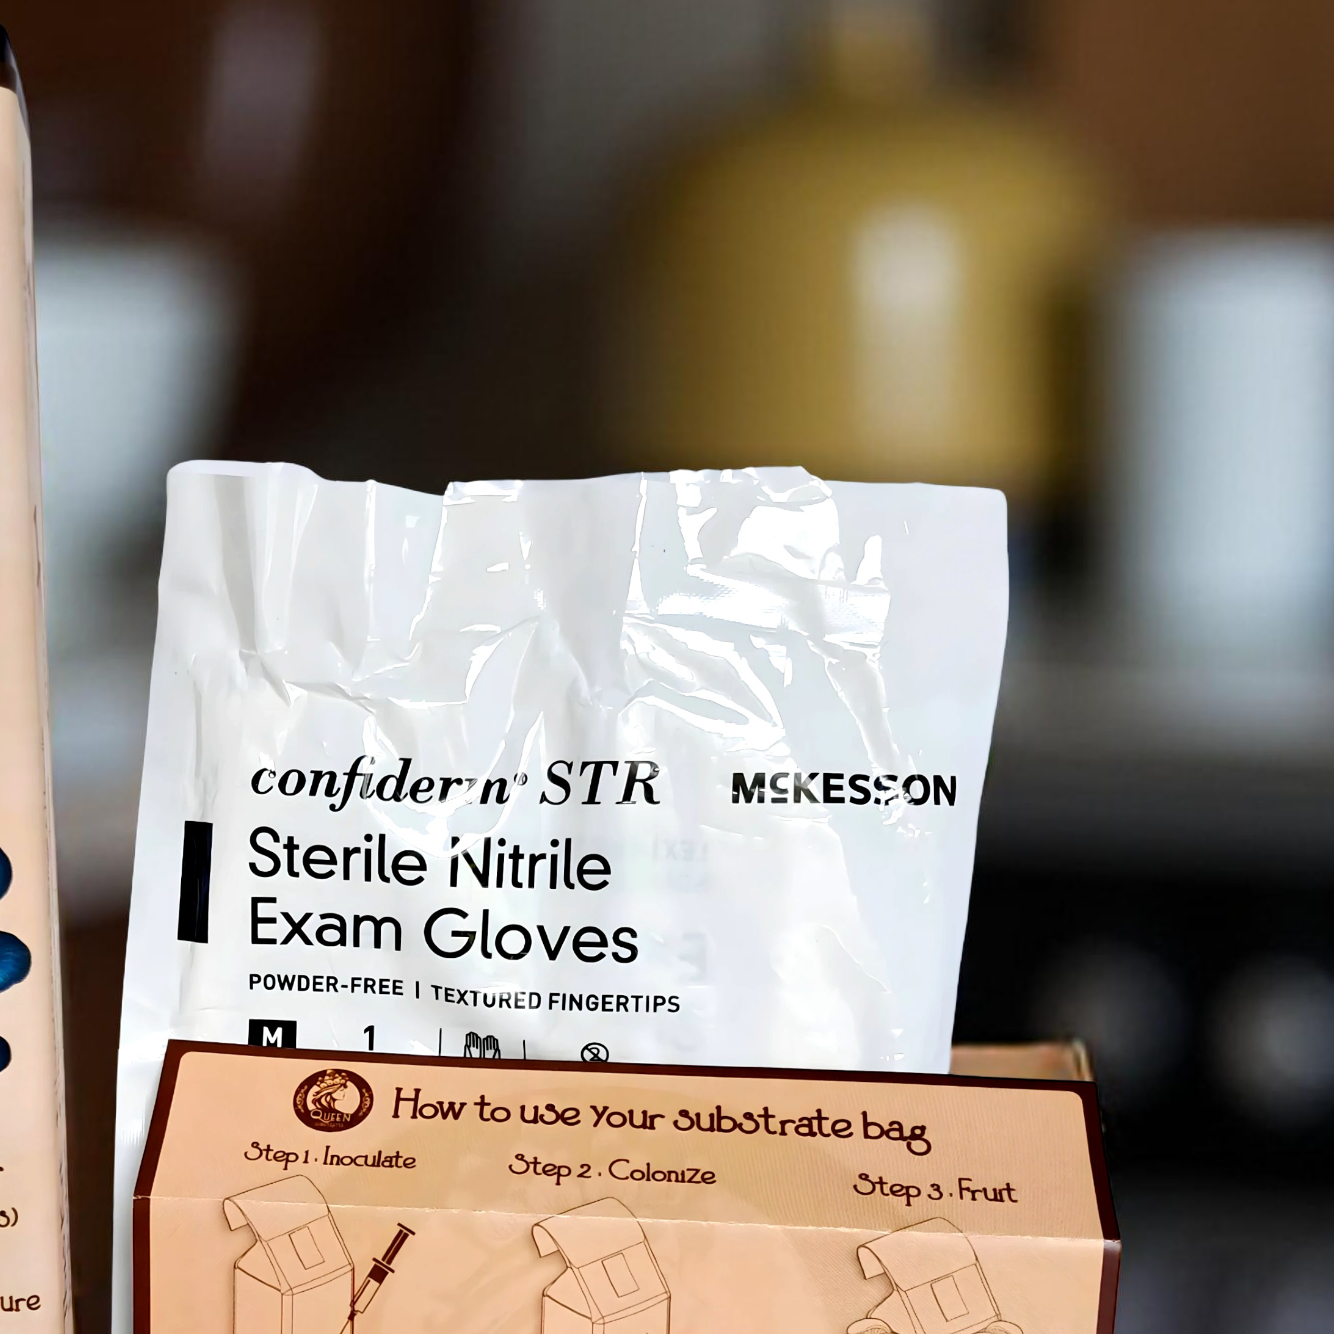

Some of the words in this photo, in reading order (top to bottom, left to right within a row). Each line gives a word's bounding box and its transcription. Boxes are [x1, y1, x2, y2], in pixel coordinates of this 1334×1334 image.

[538, 759, 661, 806] STR
[248, 825, 428, 887] Sterile
[449, 835, 612, 892] Nitrile
[250, 896, 403, 952] Exam
[423, 906, 639, 964] Gloves
[248, 973, 404, 997] POWDER-FREE
[430, 984, 542, 1010] TEXTURED
[548, 992, 681, 1014] FINGERTIPS
[262, 1026, 283, 1048] M
[310, 1109, 351, 1123] QUEEN
[391, 1086, 468, 1121] How
[473, 1094, 512, 1124] to
[519, 1102, 582, 1127] use
[589, 1104, 666, 1131] your
[672, 1104, 855, 1139] substrate
[860, 1110, 933, 1157] bag
[244, 1141, 300, 1171] Step
[322, 1145, 418, 1170] Inoculate
[508, 1153, 572, 1186] Step
[607, 1158, 717, 1185] Colonize
[852, 1172, 922, 1207] Step
[957, 1177, 1019, 1204] Fruit
